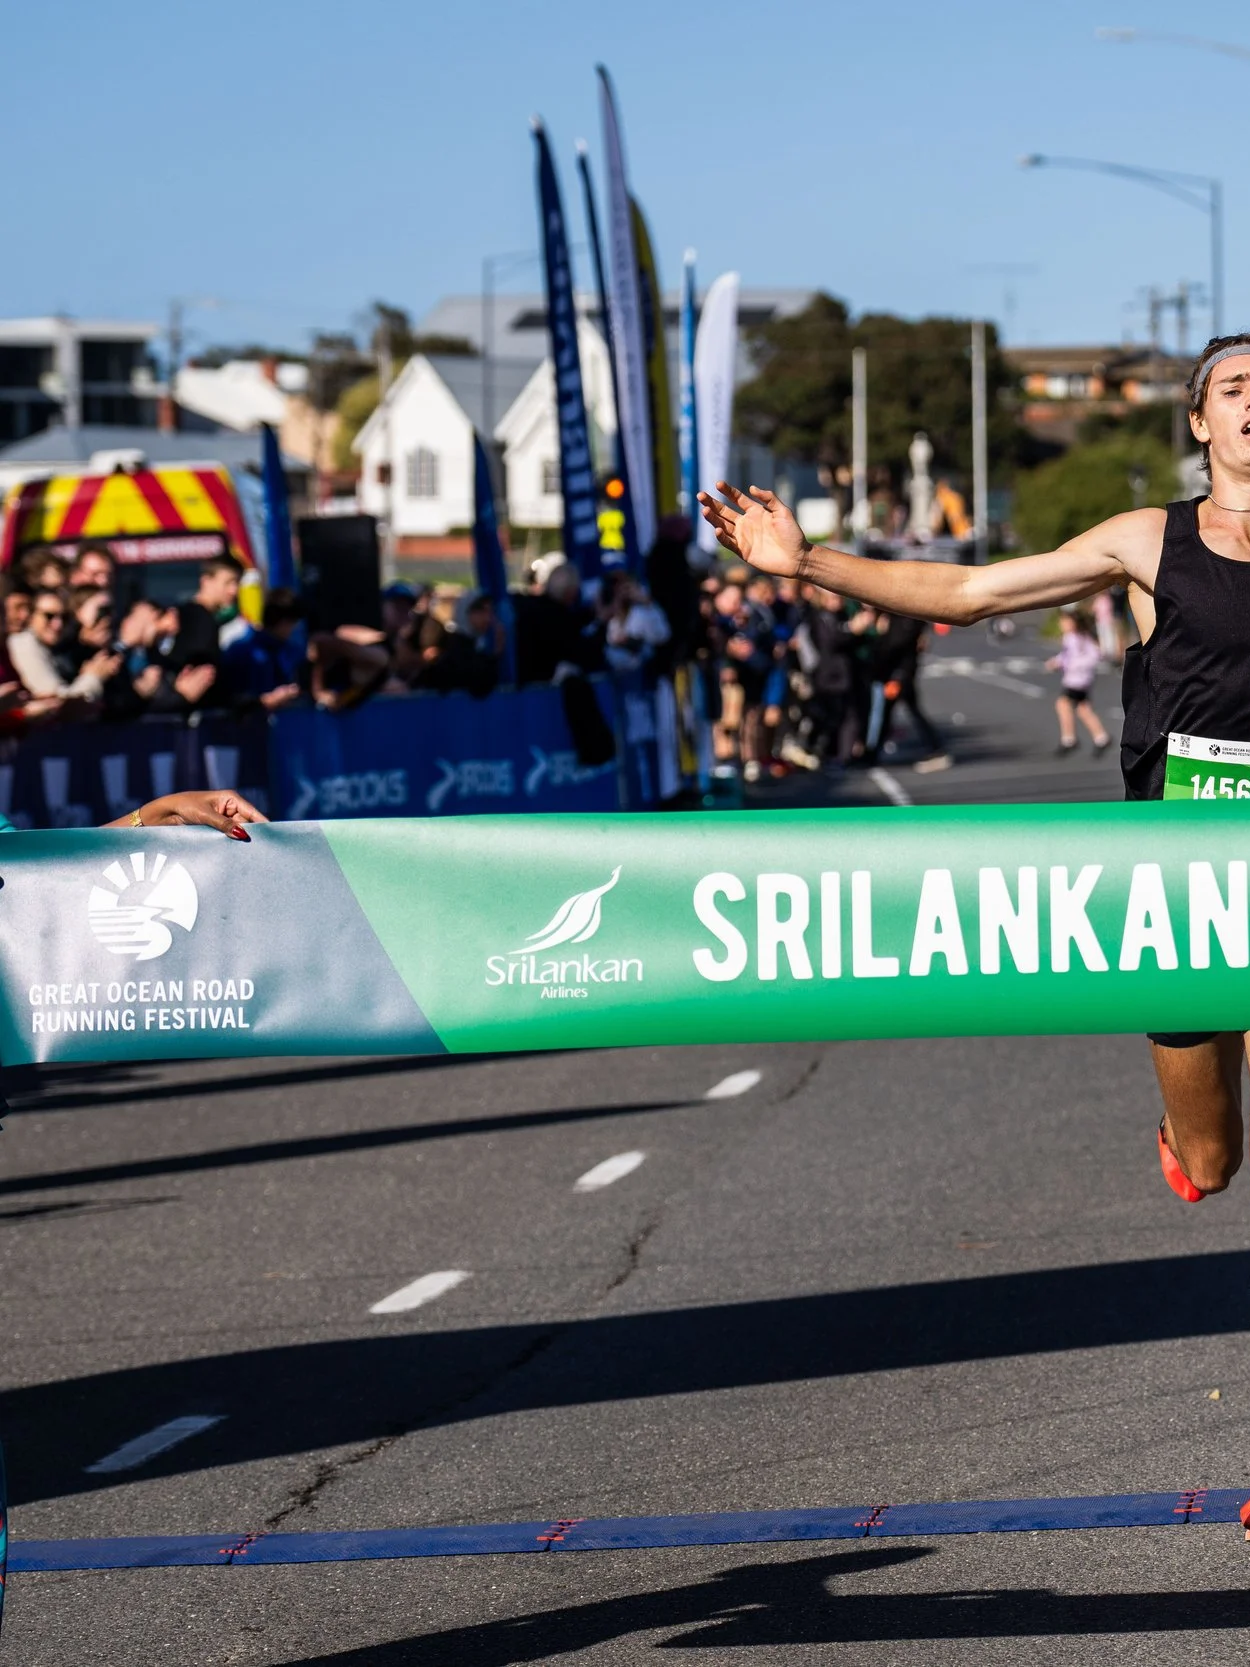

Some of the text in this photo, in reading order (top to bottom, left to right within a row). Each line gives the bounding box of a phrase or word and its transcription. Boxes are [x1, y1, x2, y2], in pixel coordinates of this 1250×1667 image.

[692, 859, 1249, 982] SRILANKAN
[485, 953, 644, 986] SriLankan
[28, 978, 255, 1006] GREAT OCEAN ROAD
[540, 986, 588, 999] Airlines
[31, 1006, 251, 1033] RUNNING FESTIVAL
